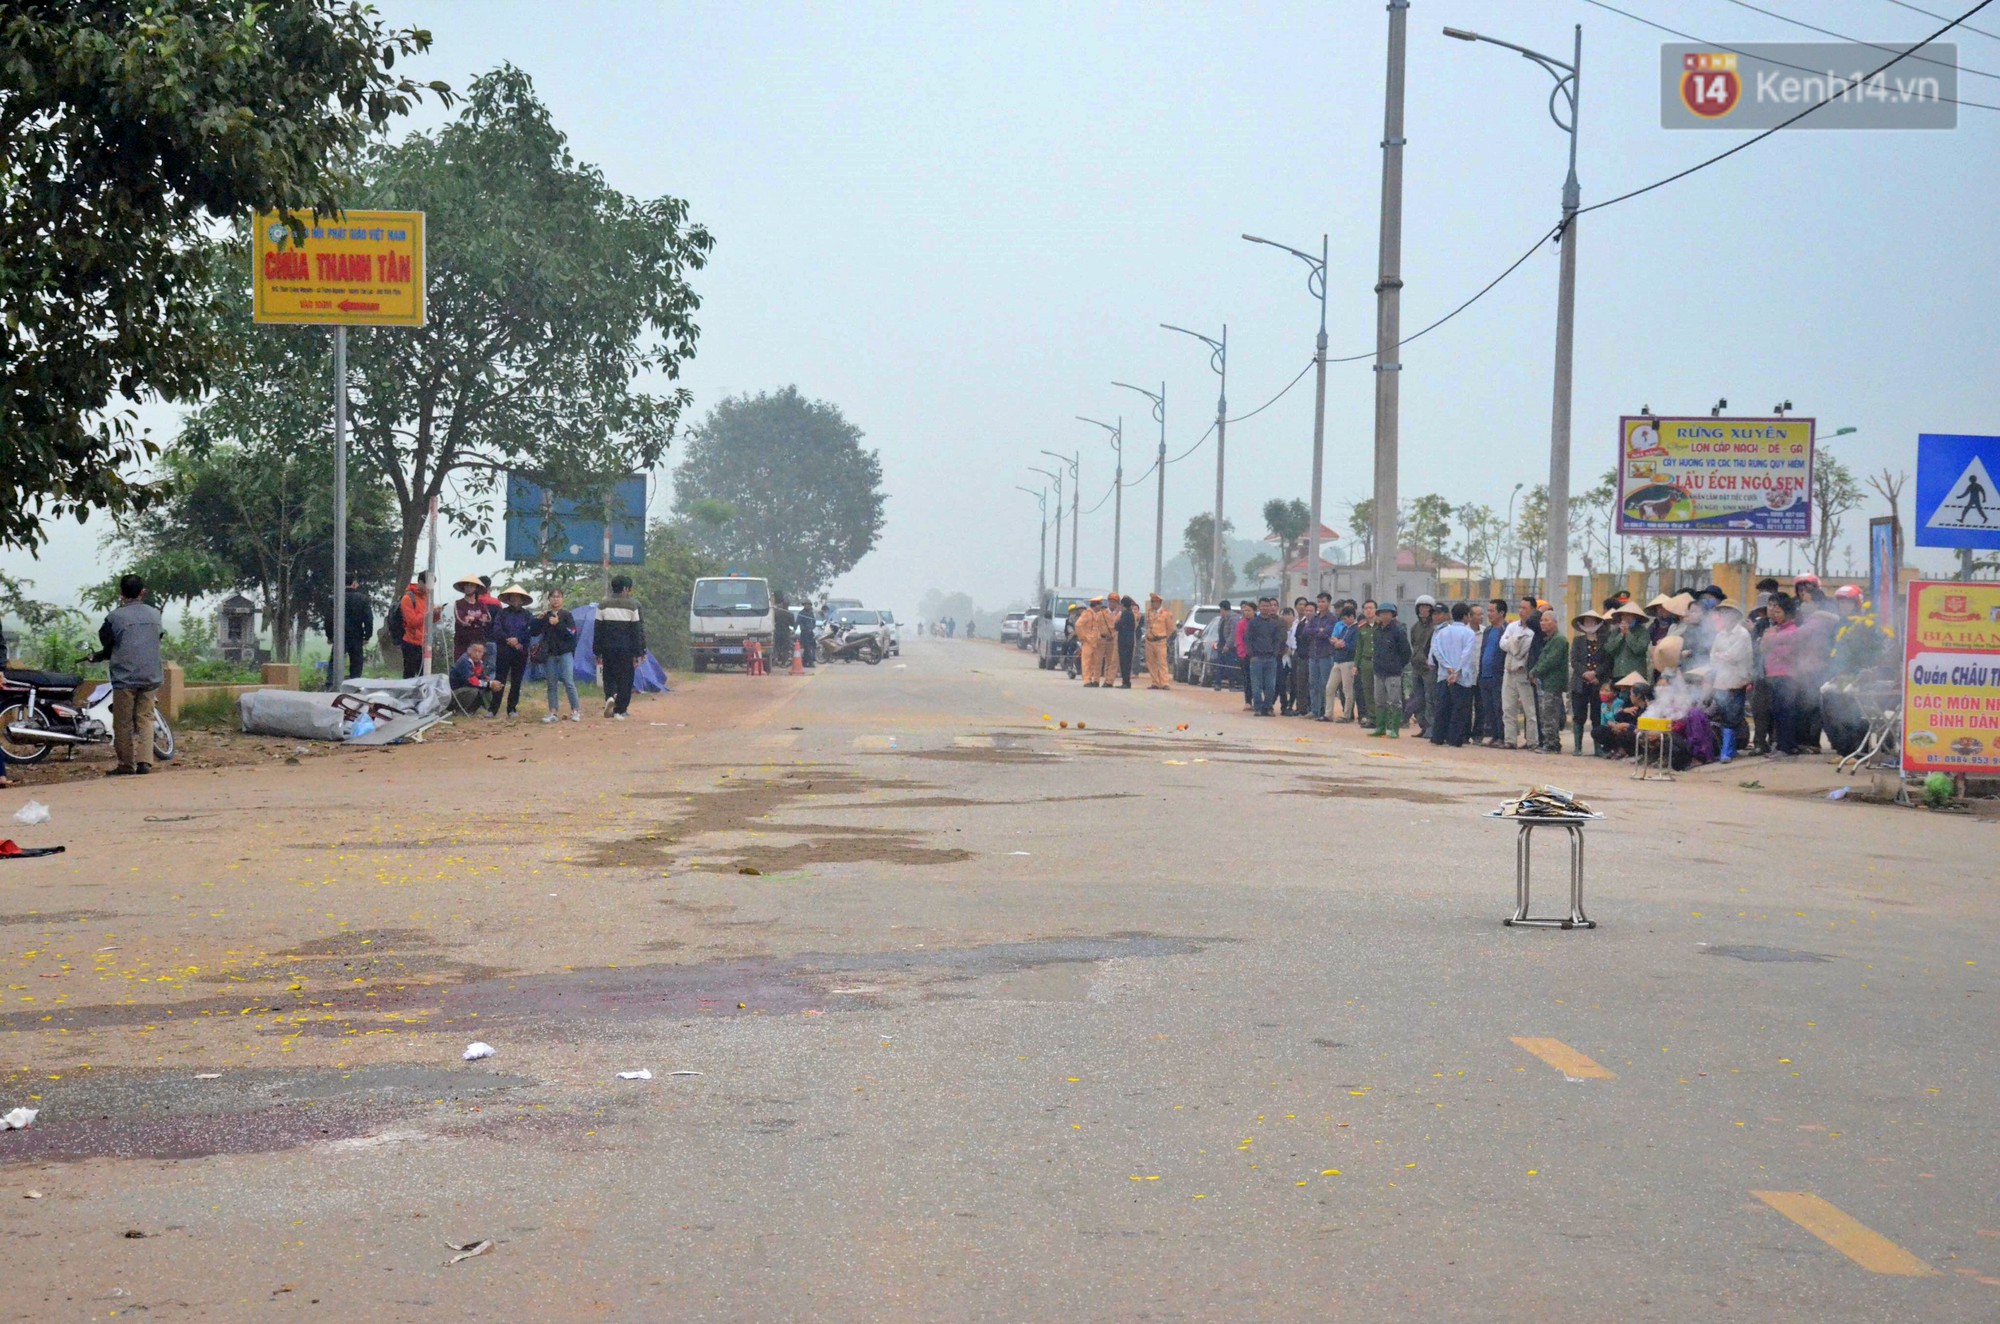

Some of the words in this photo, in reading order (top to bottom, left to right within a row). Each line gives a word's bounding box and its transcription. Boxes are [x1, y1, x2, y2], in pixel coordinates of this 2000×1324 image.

[264, 247, 310, 281] CHÙA
[316, 252, 372, 282] THANH
[1731, 425, 1787, 439] XUYÊN
[1708, 469, 1737, 490] ẾCH
[1741, 472, 1772, 490] NGÓ
[1923, 631, 1954, 642] BIA
[1914, 664, 1948, 686] Quán
[1951, 662, 1988, 687] CHÂU
[1913, 692, 1942, 709] CÁC
[1947, 694, 1981, 711] MÓN
[1929, 709, 1964, 728] BÌNH
